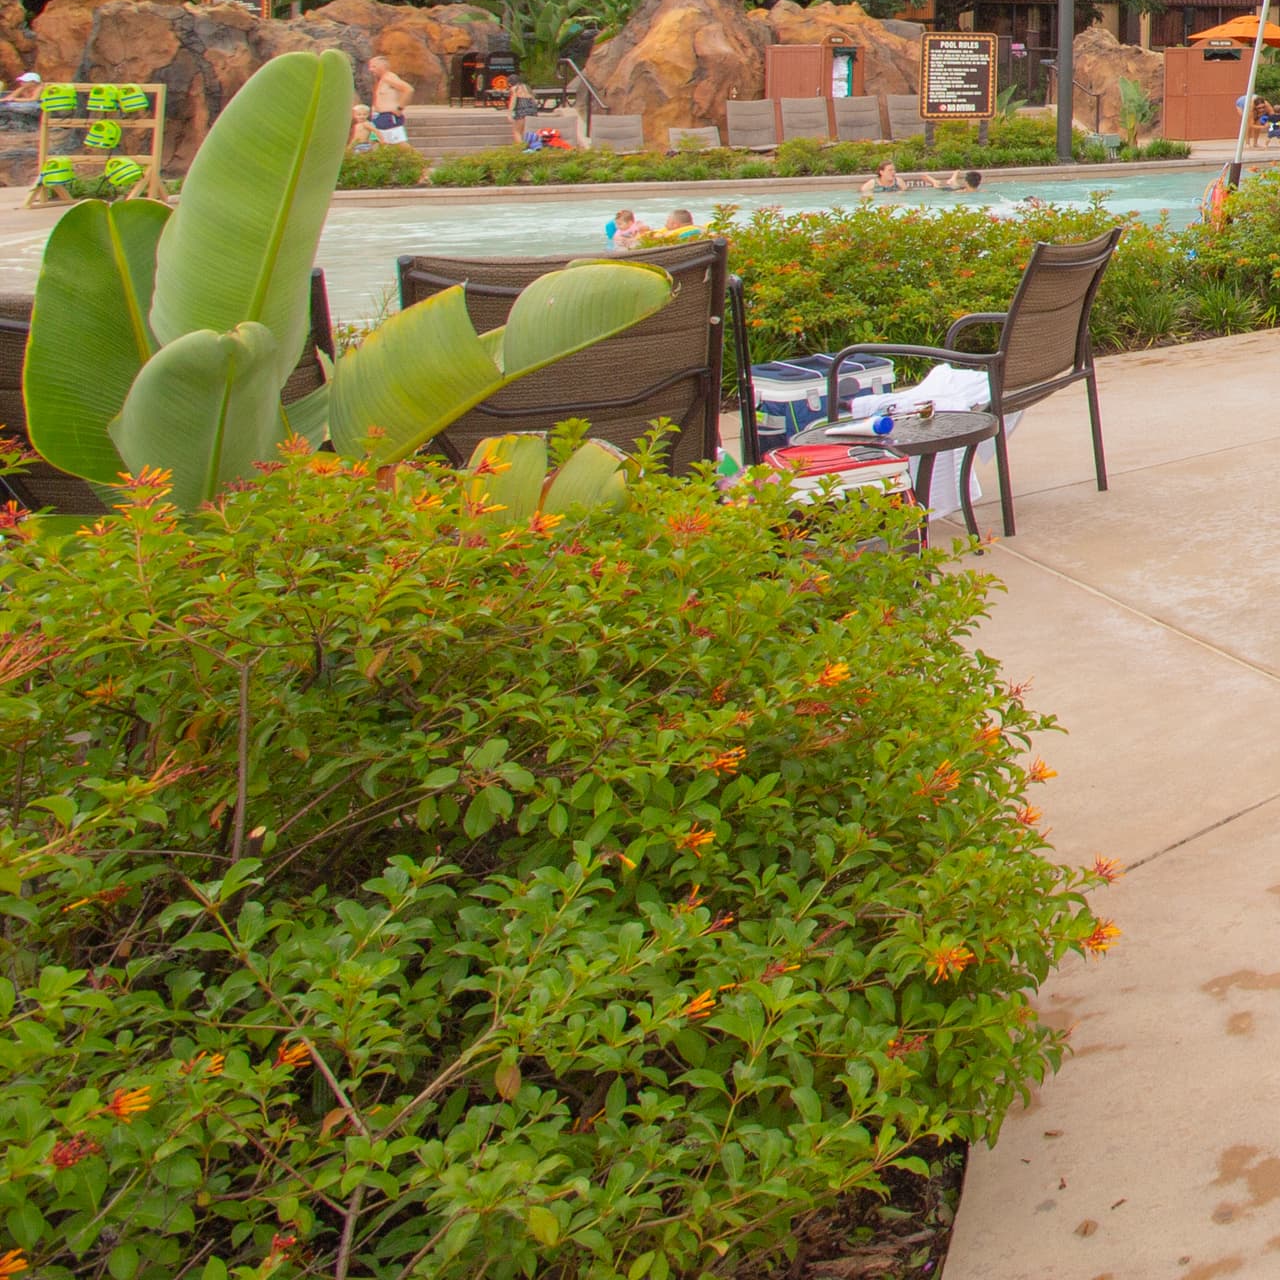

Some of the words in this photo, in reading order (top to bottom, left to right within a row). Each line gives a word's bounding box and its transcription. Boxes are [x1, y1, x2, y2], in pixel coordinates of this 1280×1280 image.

[940, 41, 957, 49] POOL
[958, 41, 979, 49] RULES
[947, 104, 956, 112] NO
